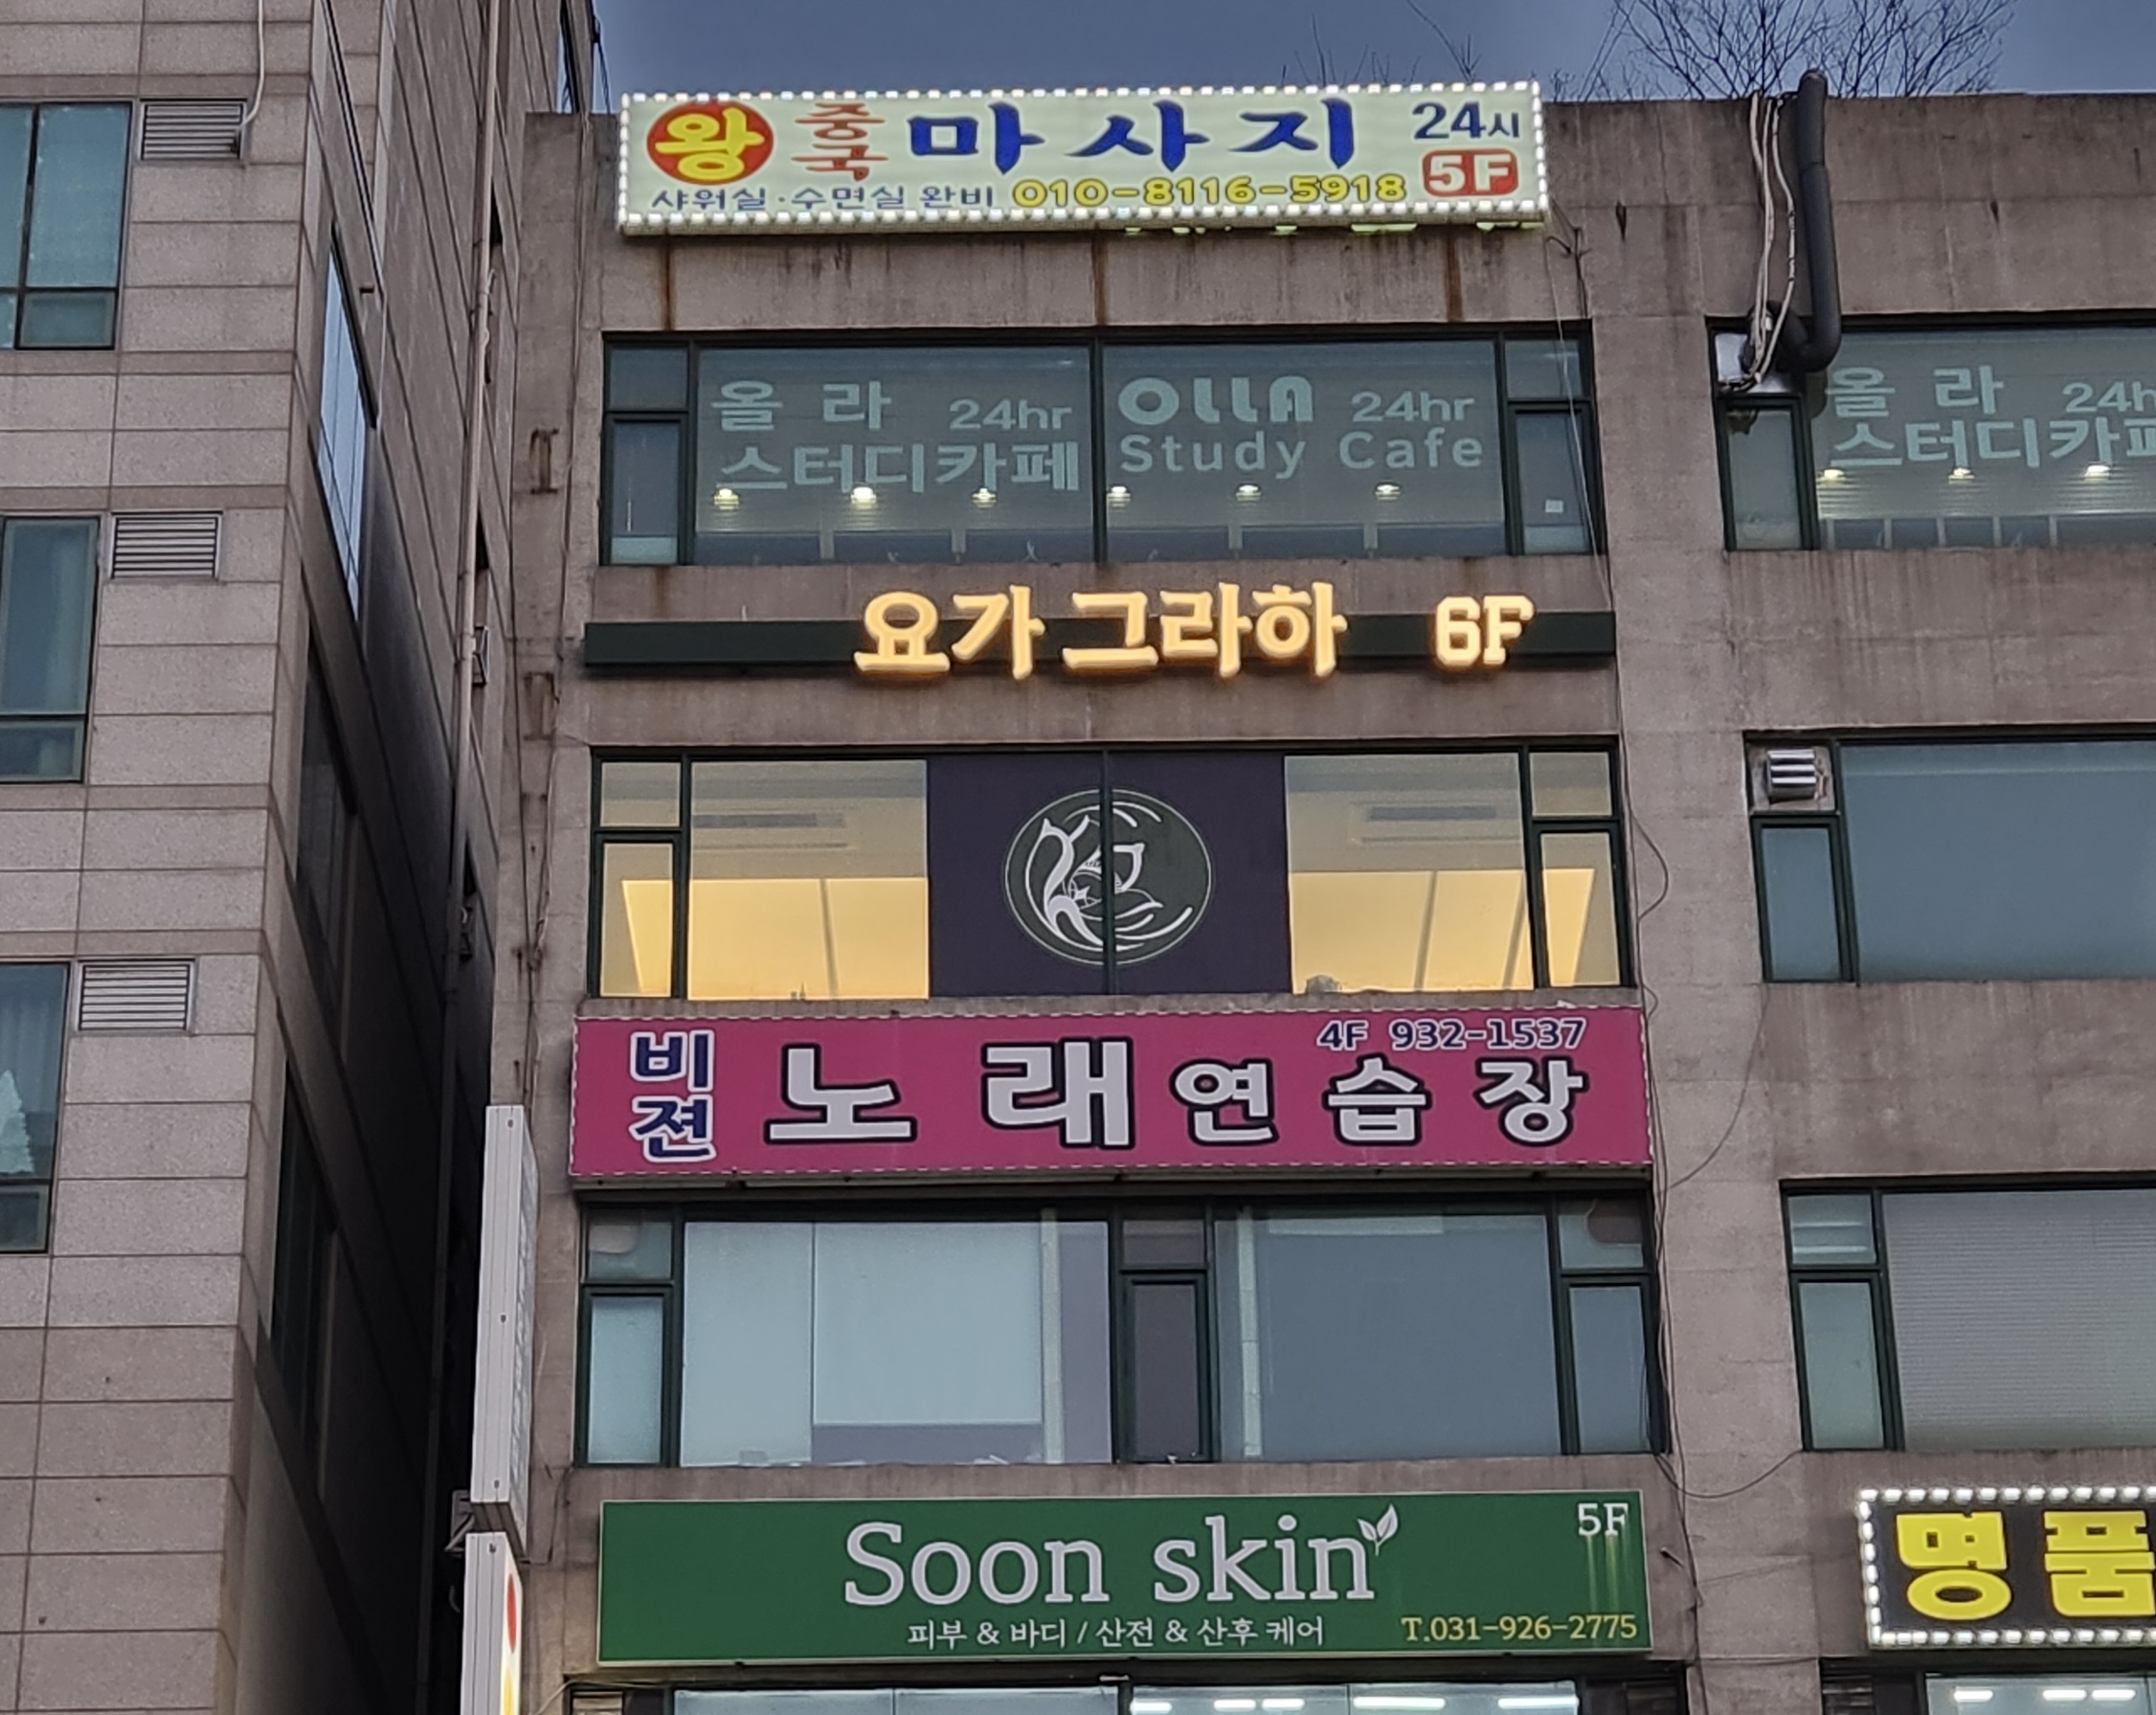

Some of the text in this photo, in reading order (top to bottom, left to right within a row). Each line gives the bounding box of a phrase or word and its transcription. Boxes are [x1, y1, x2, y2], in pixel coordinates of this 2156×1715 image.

[908, 98, 1355, 175] 마사지
[1412, 102, 1520, 140] 24시
[655, 107, 765, 181] 왕
[790, 102, 889, 182] 중국
[1012, 174, 1407, 209] 010-8116-5918
[1428, 153, 1512, 192] 5F
[919, 185, 993, 209] 완비
[949, 399, 1072, 430] 24hr
[1351, 391, 1475, 422] 24hr
[716, 442, 1079, 493] 스터디카페
[1120, 427, 1483, 480] Study Cafe
[1436, 594, 1534, 666] 6F
[1317, 1018, 1586, 1050] 4F 932-1537
[629, 1029, 717, 1162] 비젼
[1578, 1502, 1629, 1538] 5F
[844, 1515, 1376, 1606] Soon skin
[907, 1619, 968, 1651] 피부
[976, 1622, 1000, 1645] &
[1010, 1618, 1067, 1650] 바디
[1095, 1616, 1155, 1649] 산전
[1163, 1619, 1189, 1642] &
[1196, 1615, 1259, 1648] 산후
[1265, 1614, 1325, 1647] 케어
[1401, 1613, 1638, 1643] T.031-926-2775
